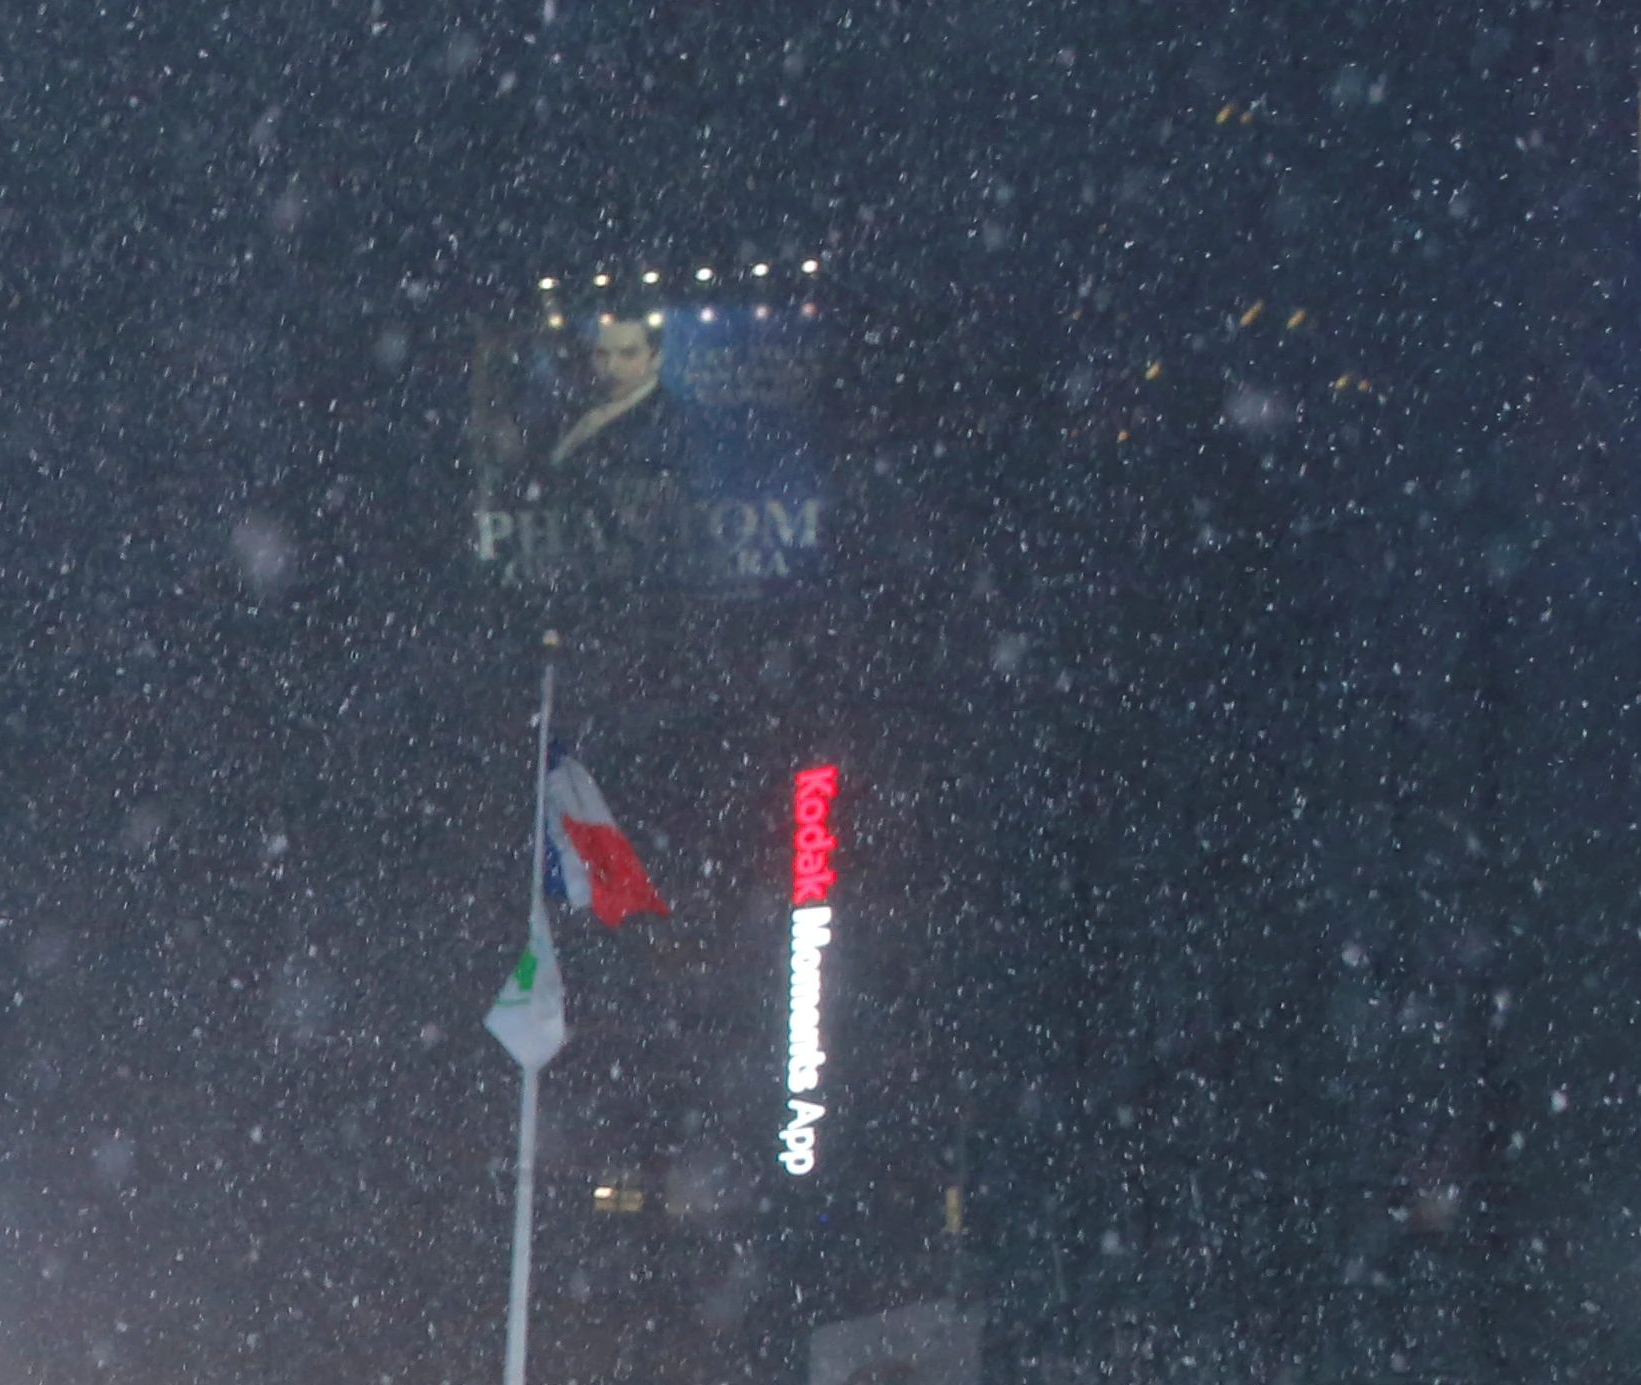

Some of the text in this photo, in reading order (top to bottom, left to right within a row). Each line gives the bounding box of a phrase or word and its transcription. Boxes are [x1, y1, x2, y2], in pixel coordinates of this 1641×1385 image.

[777, 764, 839, 1179] Kodak Moments App
